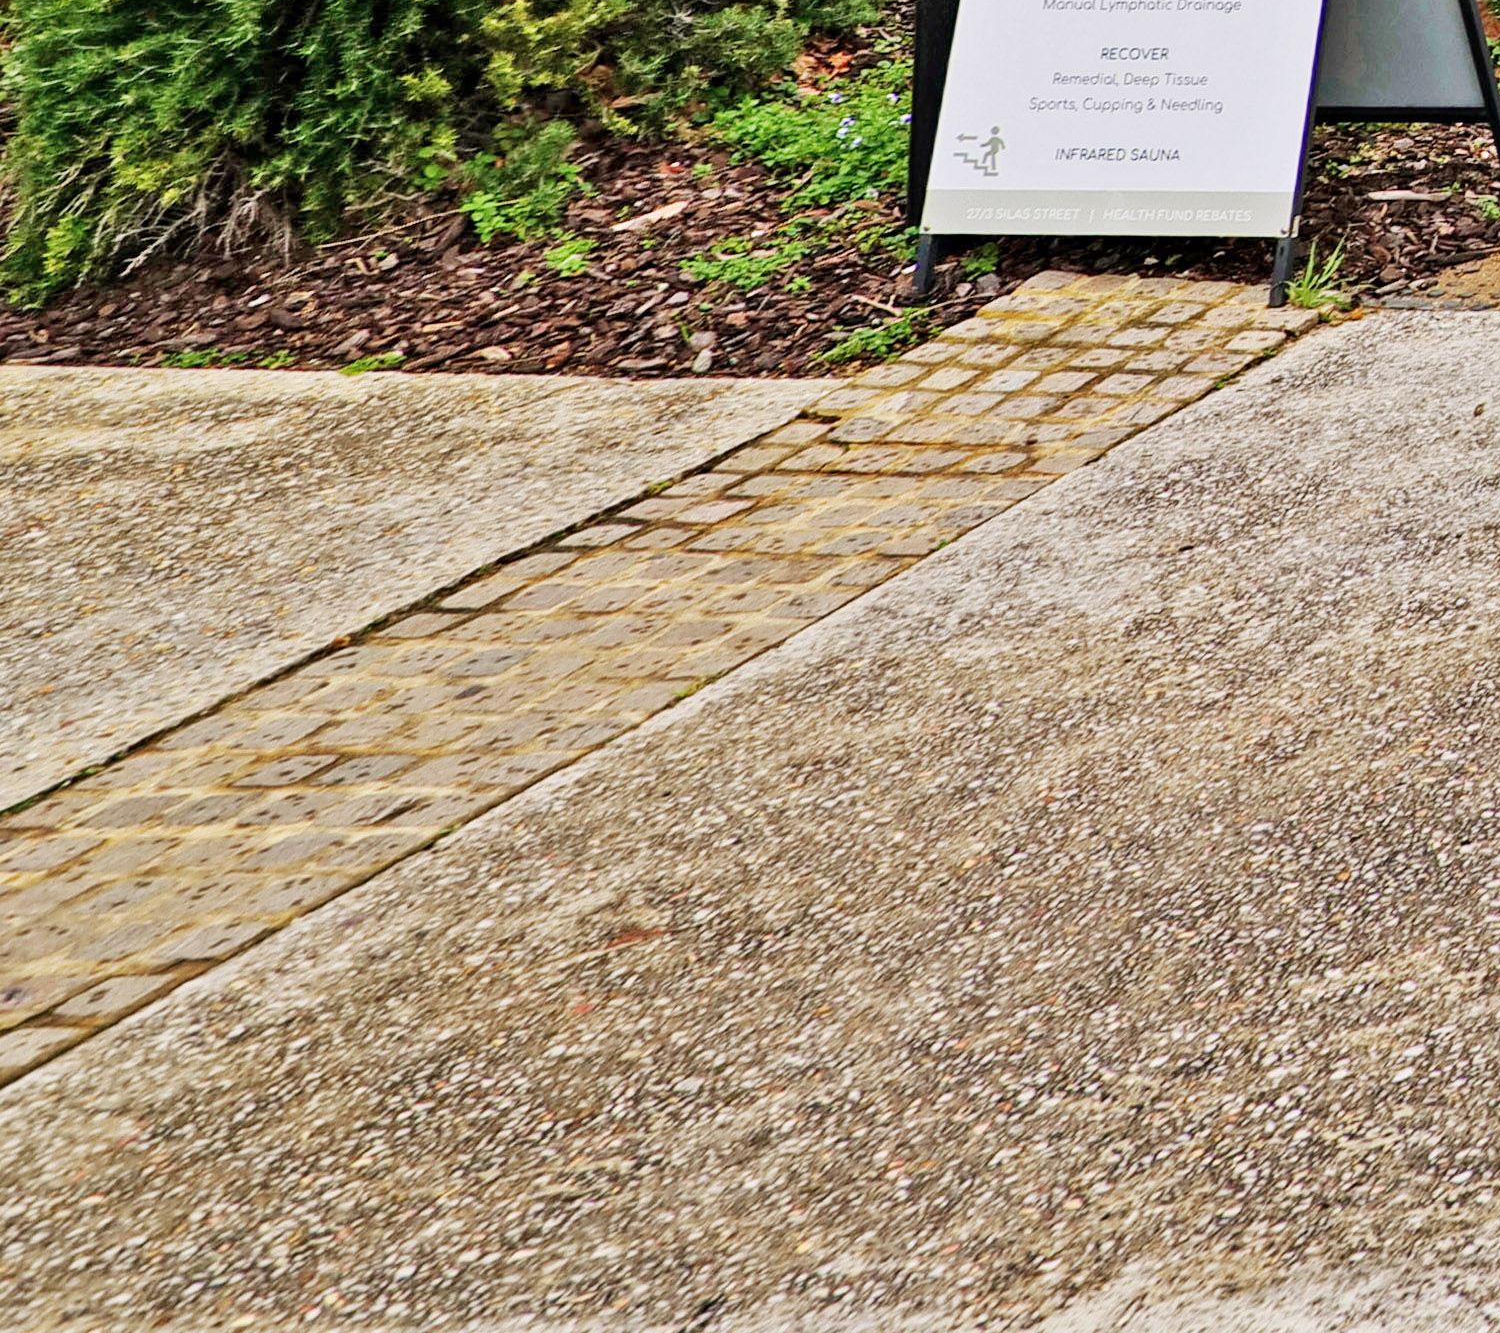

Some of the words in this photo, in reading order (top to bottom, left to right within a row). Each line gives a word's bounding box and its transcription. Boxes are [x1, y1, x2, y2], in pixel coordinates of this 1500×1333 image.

[1100, 47, 1170, 61] RECOVER
[1052, 72, 1119, 87] Remedial,
[1123, 72, 1160, 88] Deep
[1164, 72, 1209, 86] Tissue
[1029, 97, 1079, 113] Sports,
[1082, 97, 1144, 114] Cupping
[1146, 98, 1157, 111] &
[1161, 98, 1224, 115] Needling
[1055, 148, 1126, 162] INFRARED
[1130, 148, 1182, 162] SAUNA
[995, 208, 1032, 221] SILAS
[1032, 208, 1081, 222] STREET
[1102, 208, 1154, 222] HEALTH
[1157, 209, 1194, 222] FUND
[1195, 209, 1253, 223] REBATES
